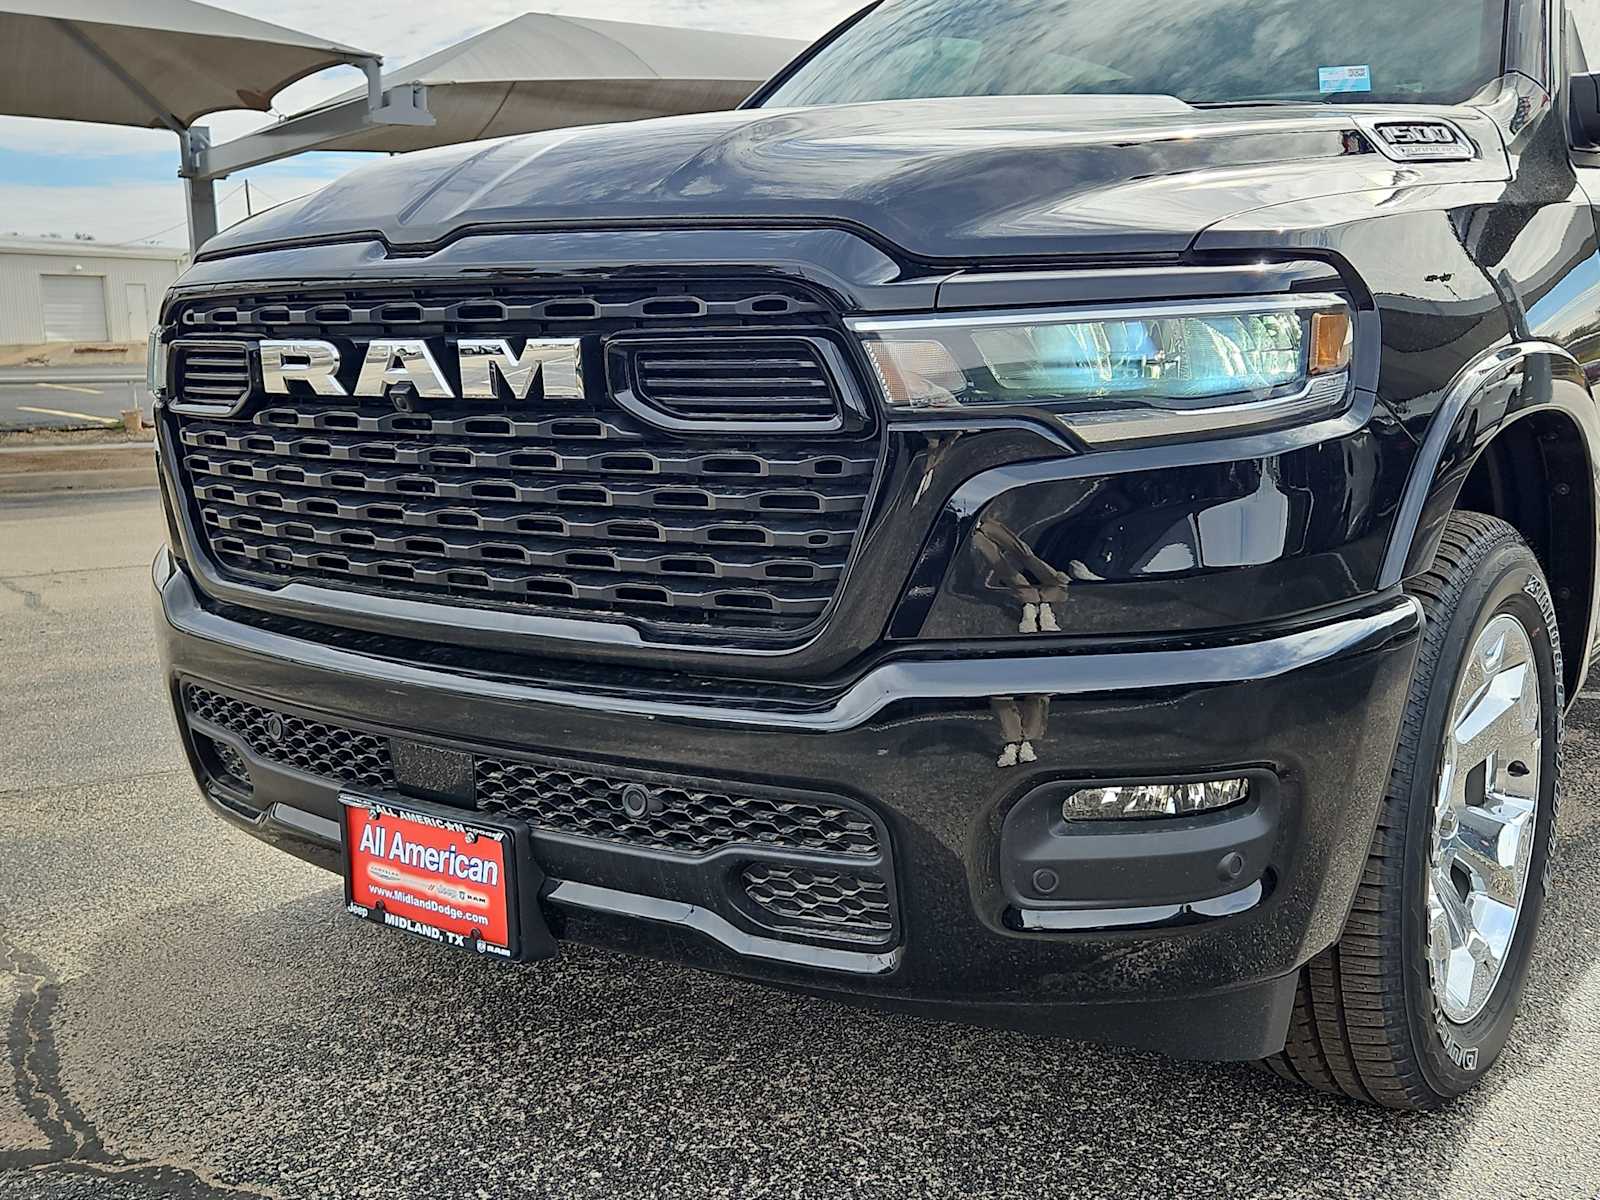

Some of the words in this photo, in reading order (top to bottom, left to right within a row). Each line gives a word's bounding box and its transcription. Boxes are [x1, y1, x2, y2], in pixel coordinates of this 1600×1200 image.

[1377, 125, 1454, 143] 1500
[259, 338, 585, 400] RAM
[375, 804, 398, 818] ALL
[360, 824, 386, 858] All
[389, 832, 498, 886] American
[347, 902, 369, 919] Jeep
[368, 885, 489, 926] www.MidlandDodge.com
[384, 912, 444, 942] MIDLAND,
[446, 932, 465, 948] TX
[486, 945, 511, 957] RAM
